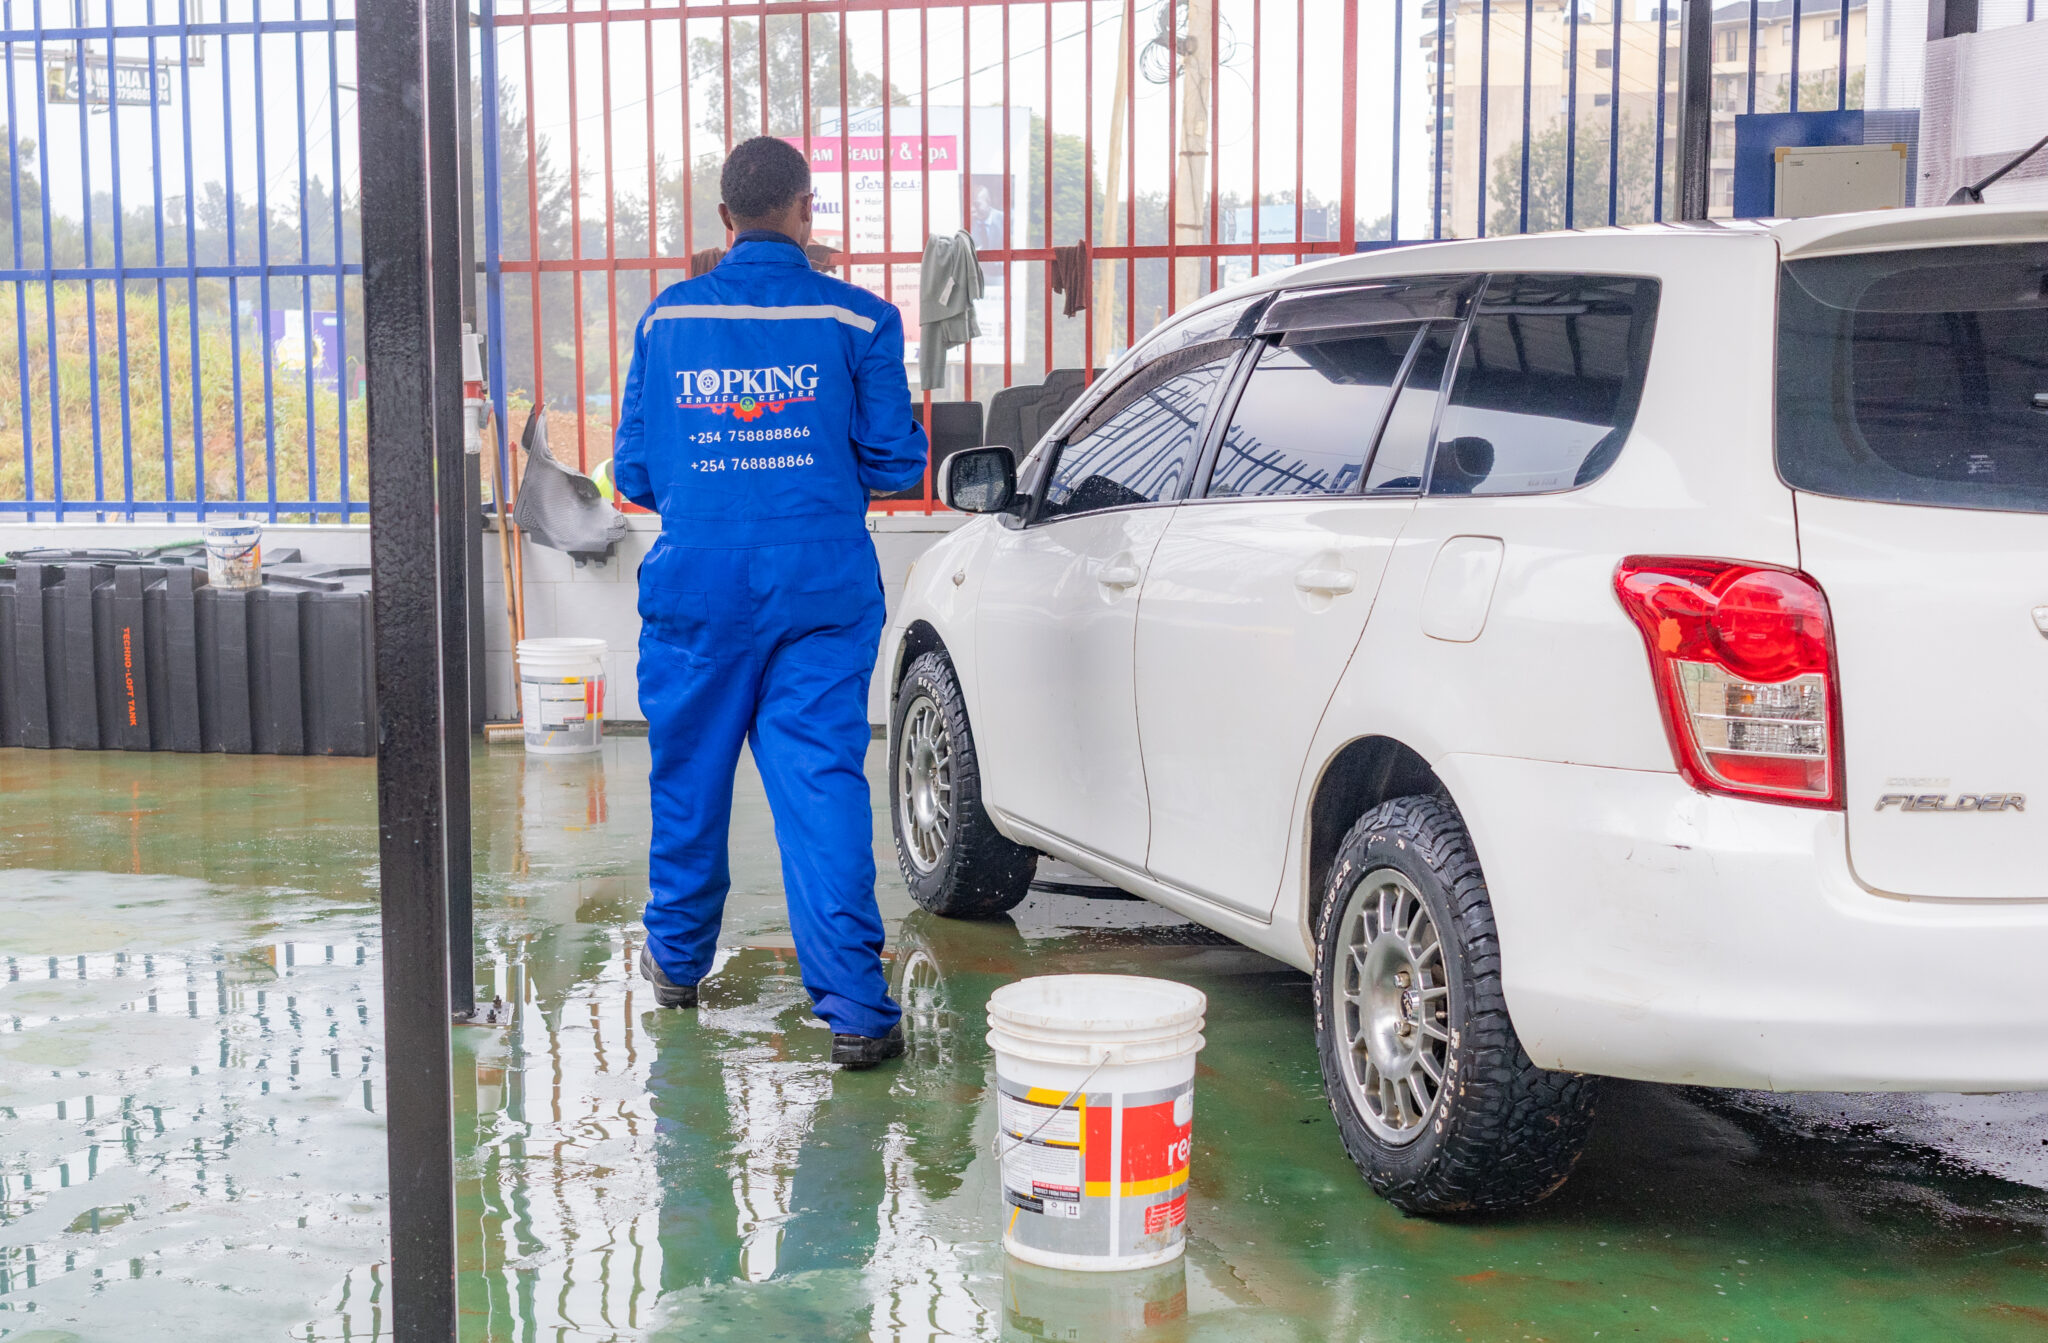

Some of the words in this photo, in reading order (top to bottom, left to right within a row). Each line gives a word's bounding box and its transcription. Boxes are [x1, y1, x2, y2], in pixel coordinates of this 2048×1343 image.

[96, 68, 142, 88] MDIA
[144, 70, 169, 90] LD
[900, 142, 913, 161] &
[676, 363, 820, 396] TOPKING
[675, 394, 739, 404] SERVICE
[758, 390, 815, 402] CENTER
[688, 431, 722, 444] +254
[728, 426, 811, 442] 758888866
[691, 459, 726, 472] +254
[731, 453, 814, 471] 768888866
[128, 699, 137, 726] TANK
[1874, 793, 2026, 812] FIELDER
